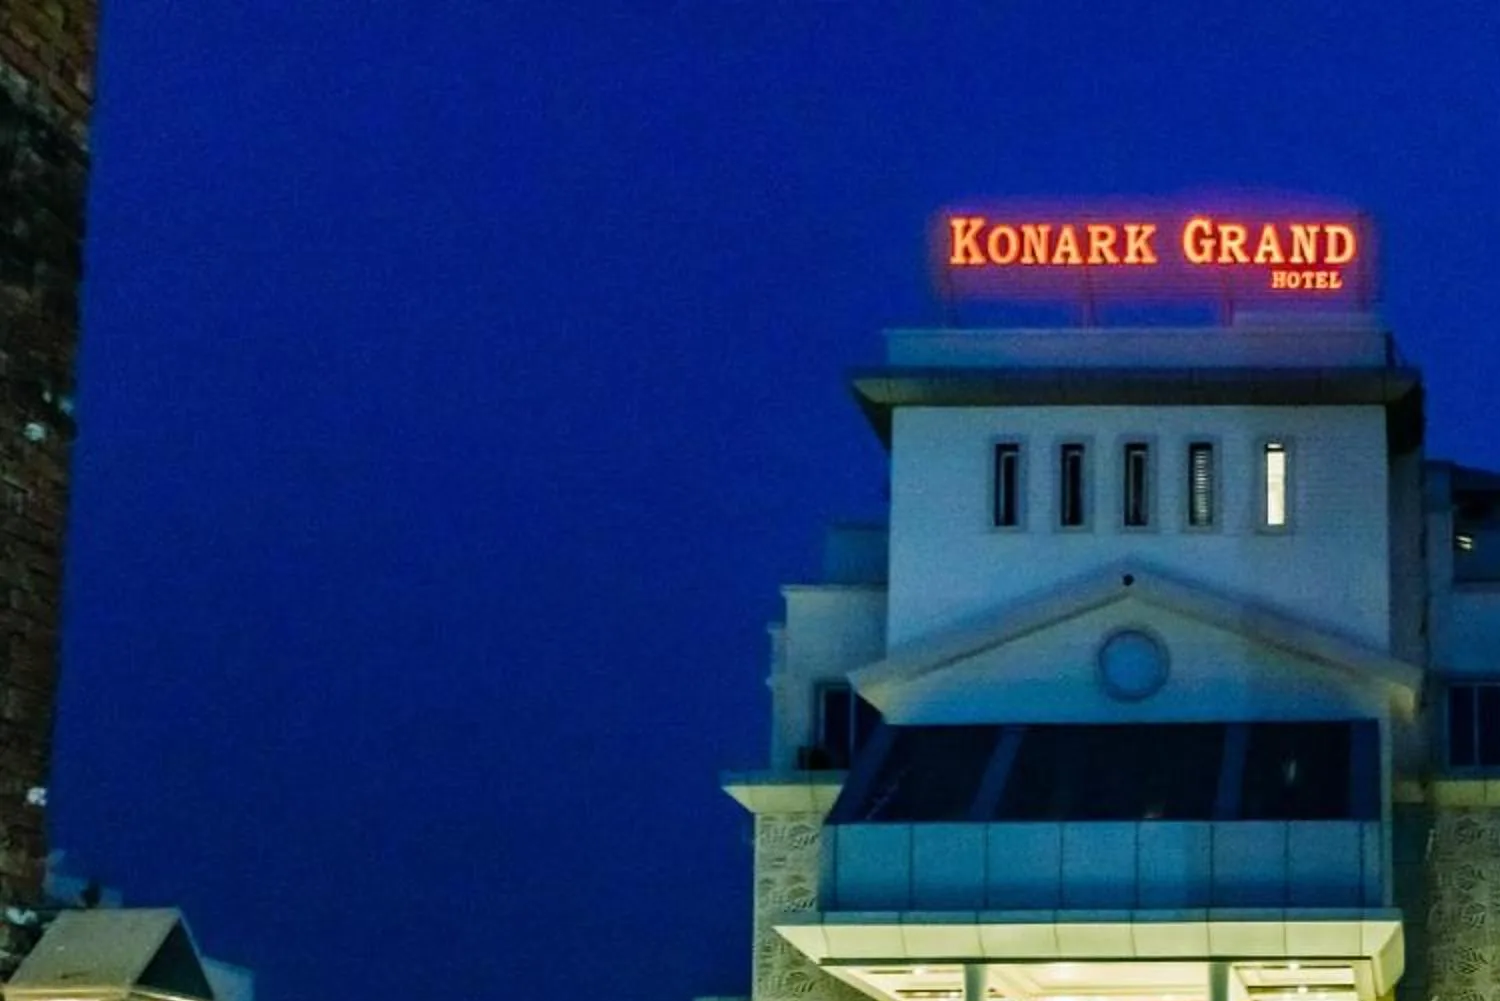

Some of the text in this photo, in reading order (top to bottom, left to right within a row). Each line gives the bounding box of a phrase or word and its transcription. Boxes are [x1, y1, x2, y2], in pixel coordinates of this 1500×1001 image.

[949, 213, 1357, 266] KONARK GRAND
[1270, 271, 1343, 289] HOTEL
